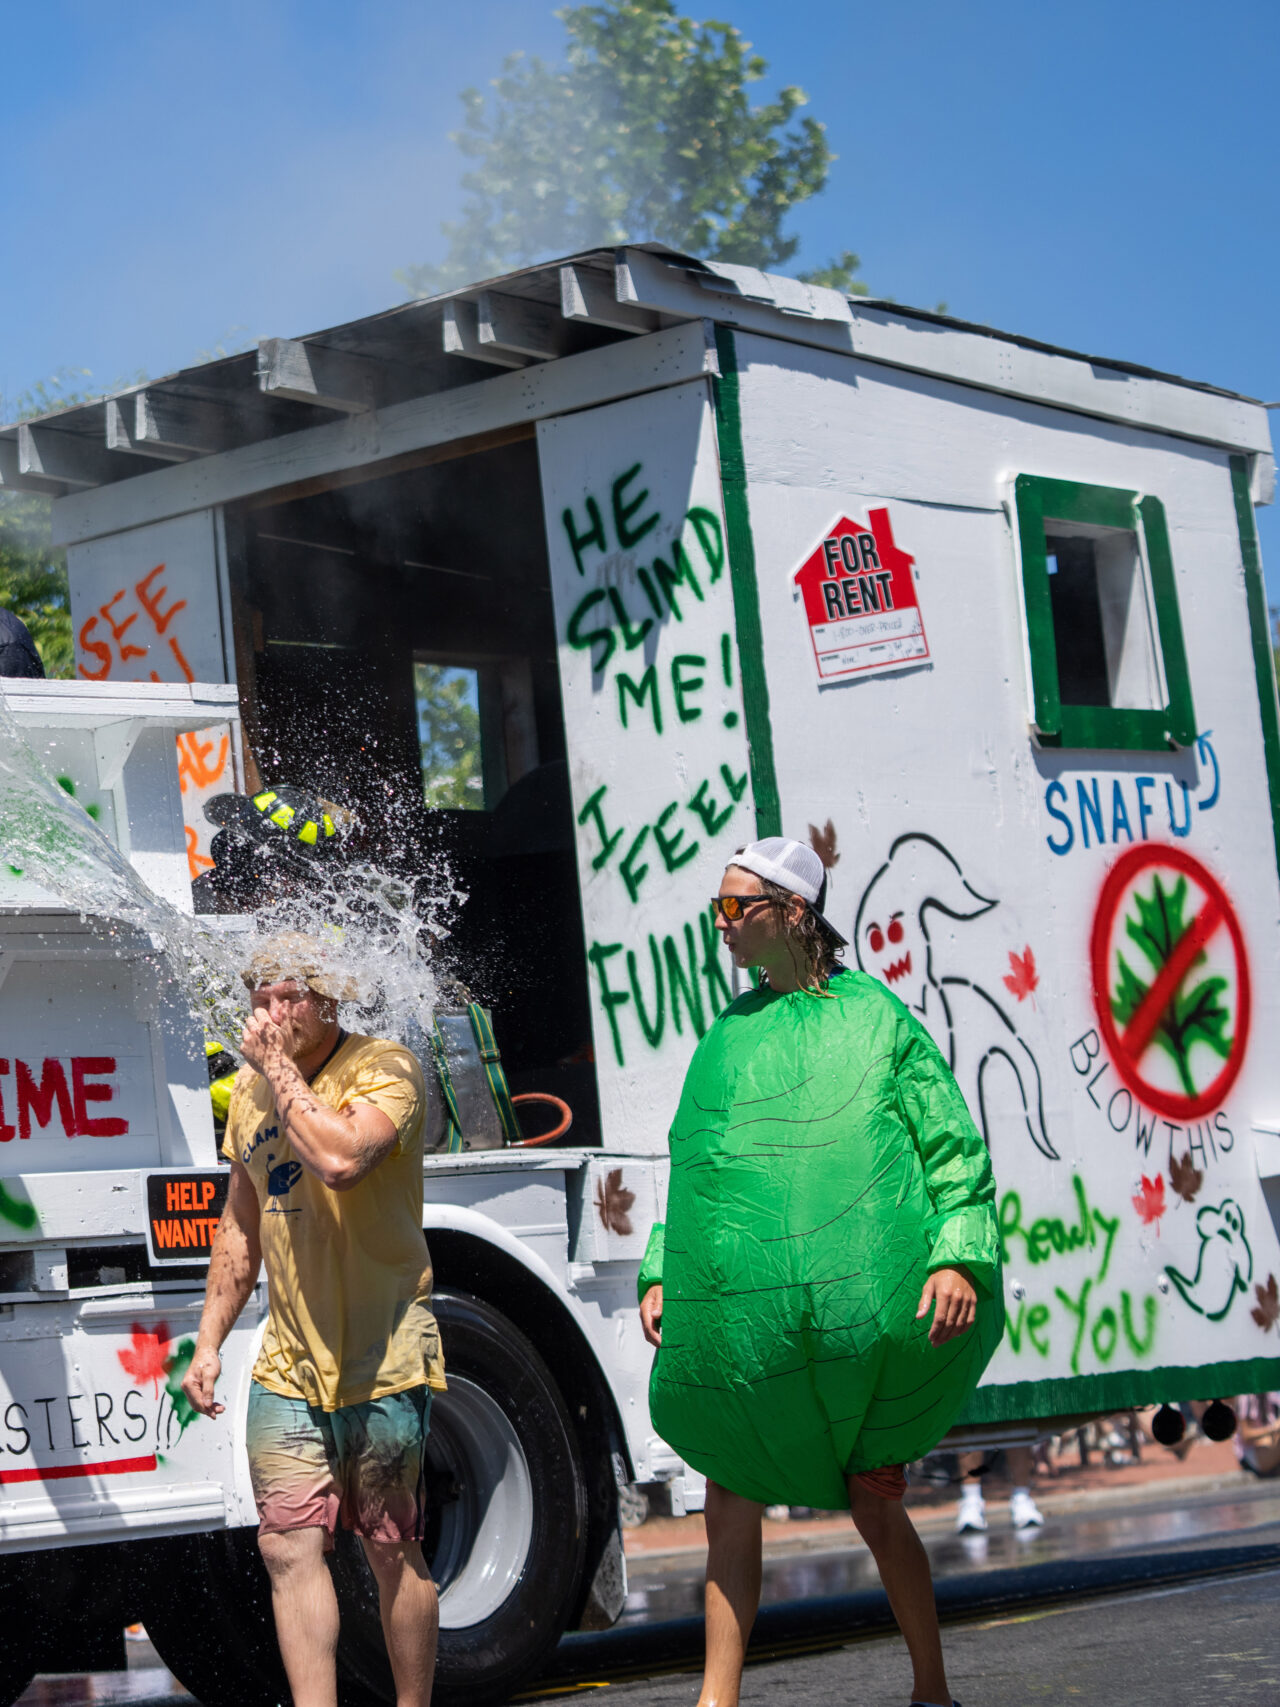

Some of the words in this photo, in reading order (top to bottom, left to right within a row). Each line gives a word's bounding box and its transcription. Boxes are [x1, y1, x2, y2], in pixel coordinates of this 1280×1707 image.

[563, 463, 661, 576] HE
[823, 533, 881, 577] FOR
[78, 563, 188, 681] SEE
[567, 506, 725, 672] SLIMD
[822, 572, 893, 620] RENT
[615, 632, 738, 735] ME!
[578, 784, 625, 871] I
[619, 763, 748, 904] FEEL
[1045, 777, 1192, 856] SNAFU
[588, 903, 759, 1067] FUNK
[242, 1126, 279, 1163] CLAM
[166, 1182, 216, 1212] HELP
